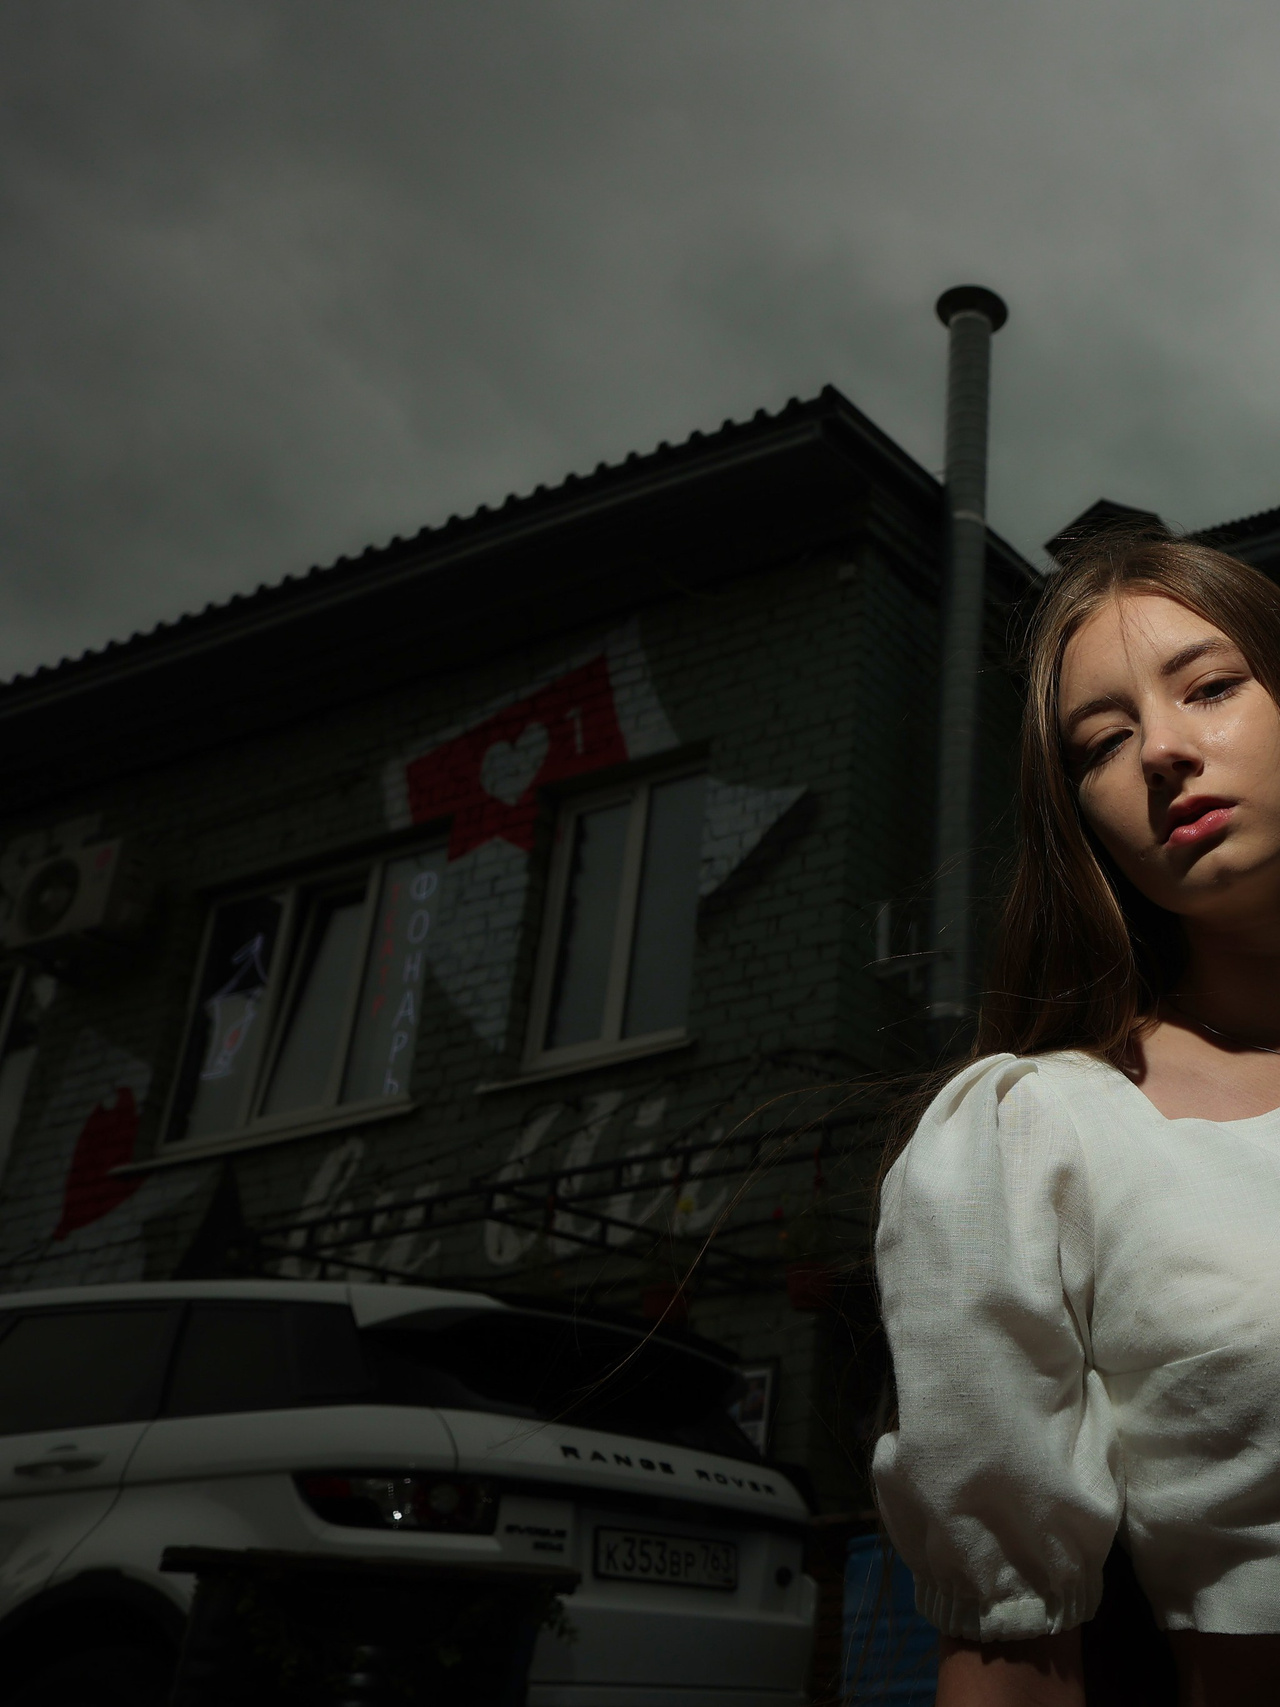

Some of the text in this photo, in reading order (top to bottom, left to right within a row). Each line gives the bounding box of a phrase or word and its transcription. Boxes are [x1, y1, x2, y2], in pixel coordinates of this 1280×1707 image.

[382, 870, 438, 1096] ФОНАРЬ
[560, 1445, 777, 1496] RANGE ROVER
